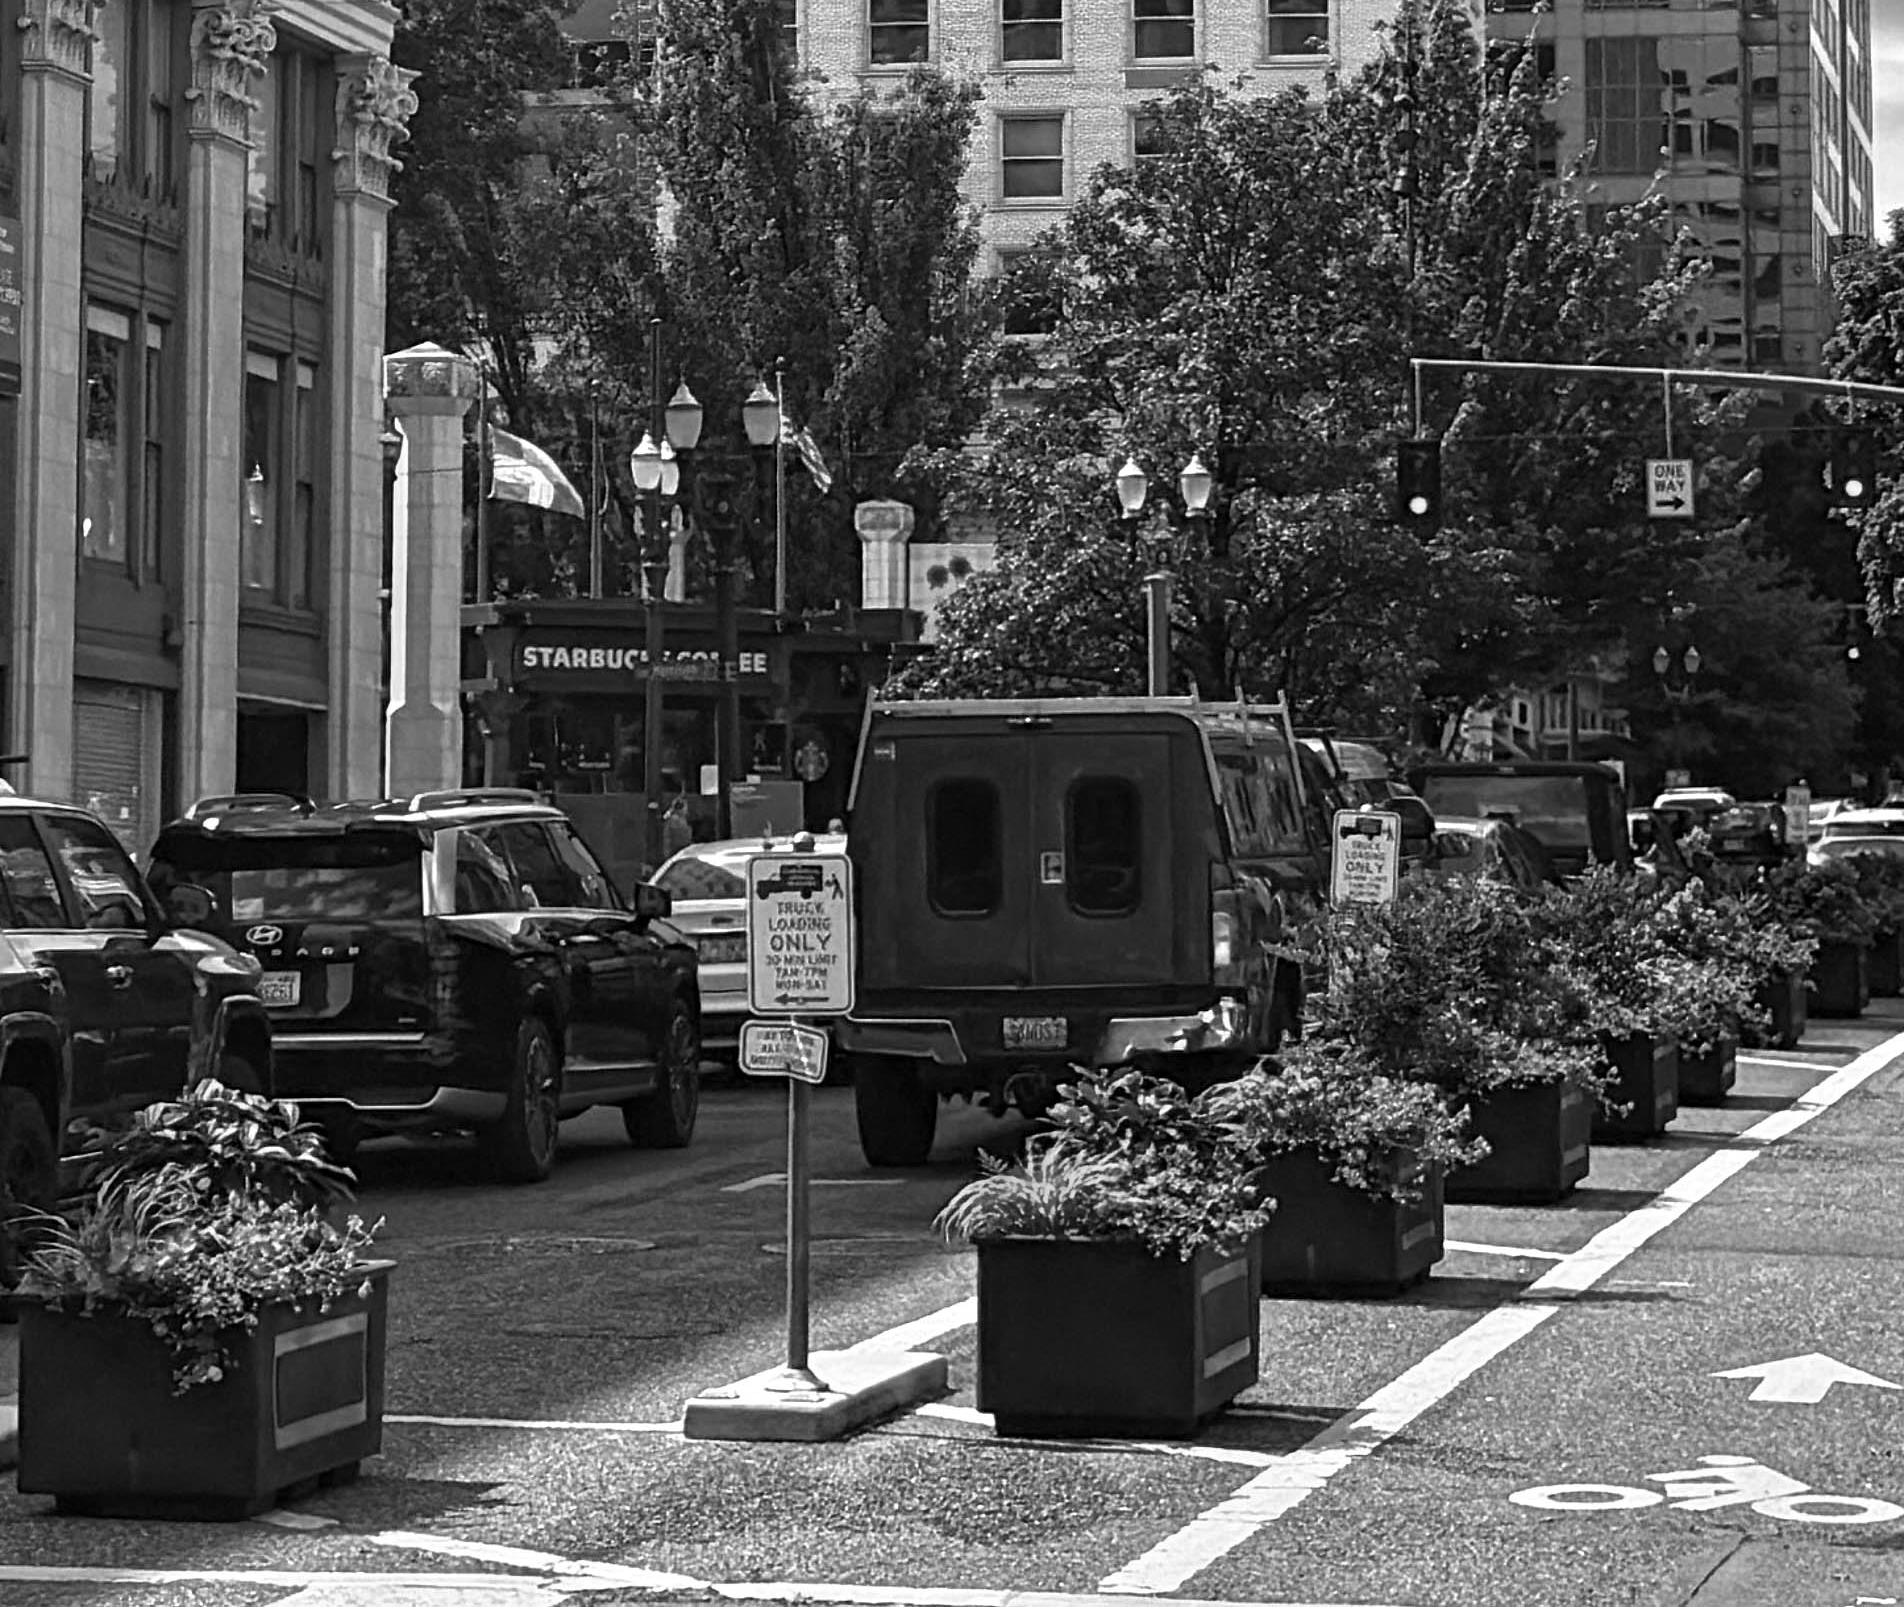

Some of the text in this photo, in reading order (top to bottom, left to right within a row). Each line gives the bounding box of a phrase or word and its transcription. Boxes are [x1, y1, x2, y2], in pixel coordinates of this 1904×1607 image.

[1654, 464, 1686, 479] ONE
[1654, 479, 1686, 492] WAY
[523, 646, 671, 671] STARBUC
[768, 916, 832, 932] LOADING
[769, 932, 832, 953] ONLY
